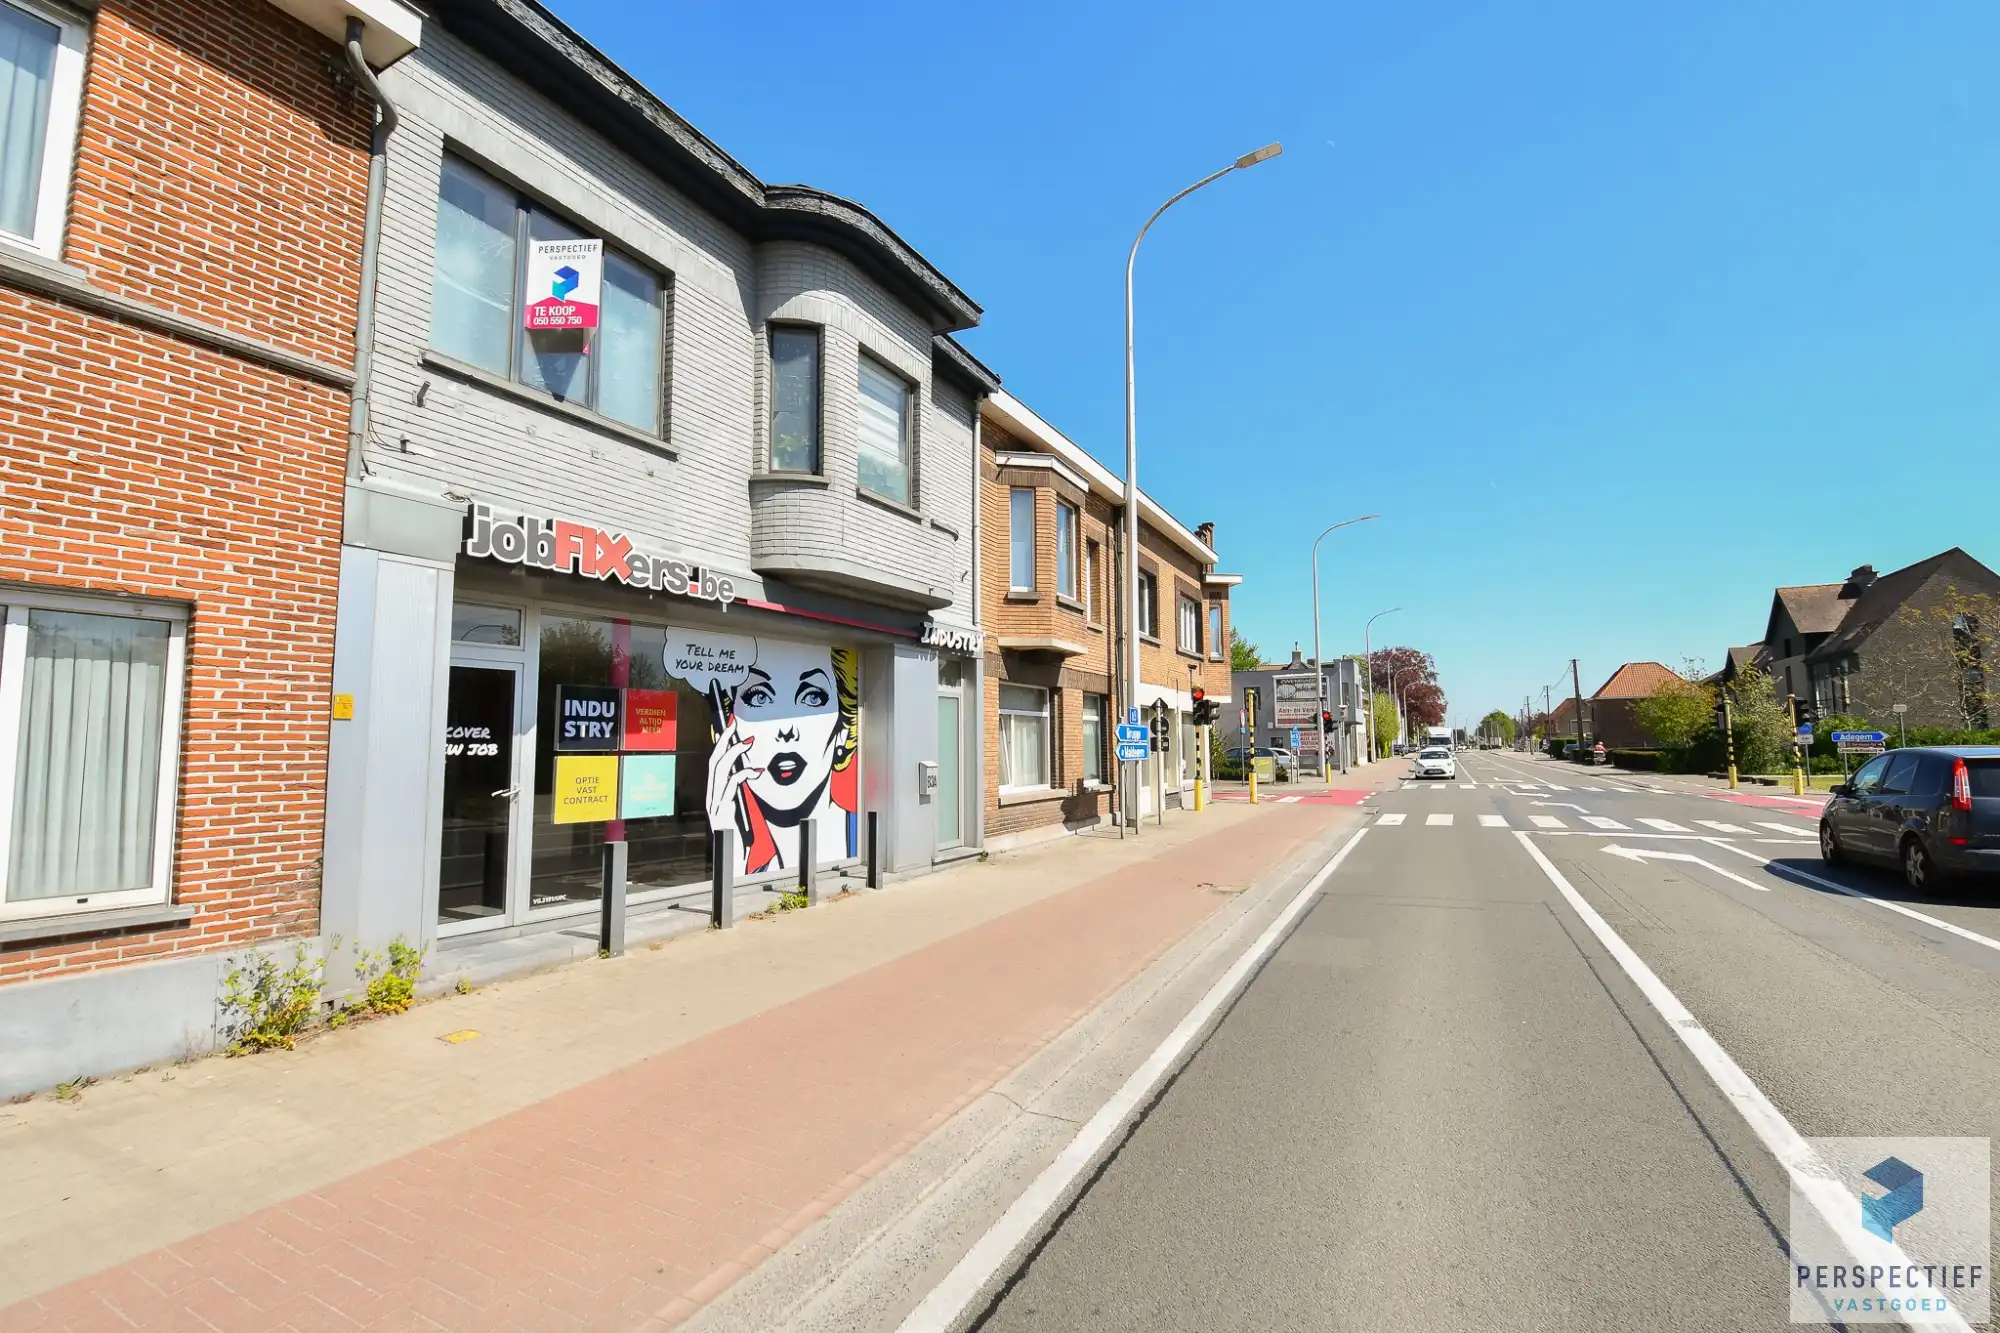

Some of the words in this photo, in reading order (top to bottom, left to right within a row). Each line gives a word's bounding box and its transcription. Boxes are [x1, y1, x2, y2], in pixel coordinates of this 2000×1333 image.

[538, 244, 598, 254] PERSPECTIEF
[534, 306, 547, 316] TE
[548, 305, 576, 315] KOOP
[533, 317, 549, 325] 050
[550, 316, 565, 325] 550
[567, 316, 582, 324] 750
[467, 503, 735, 602] jobFIXers.be
[921, 622, 985, 653] INDUSTRY
[686, 644, 714, 658] TELL
[719, 648, 736, 660] ME
[675, 658, 703, 672] YOUR
[707, 661, 744, 673] DREAM
[564, 699, 615, 718] INDU
[635, 707, 666, 717] VERDIEN
[639, 717, 662, 726] ALTIJD
[446, 726, 491, 739] COVER
[564, 720, 614, 739] STRY
[641, 726, 661, 734] MEER
[1126, 727, 1142, 742] Brugge
[1839, 733, 1873, 741] Adegem
[467, 743, 498, 756] JOB
[1124, 746, 1145, 759] Maldegem
[575, 776, 600, 785] OPTIE
[576, 786, 597, 794] VAST
[563, 795, 609, 805] CONTRACT
